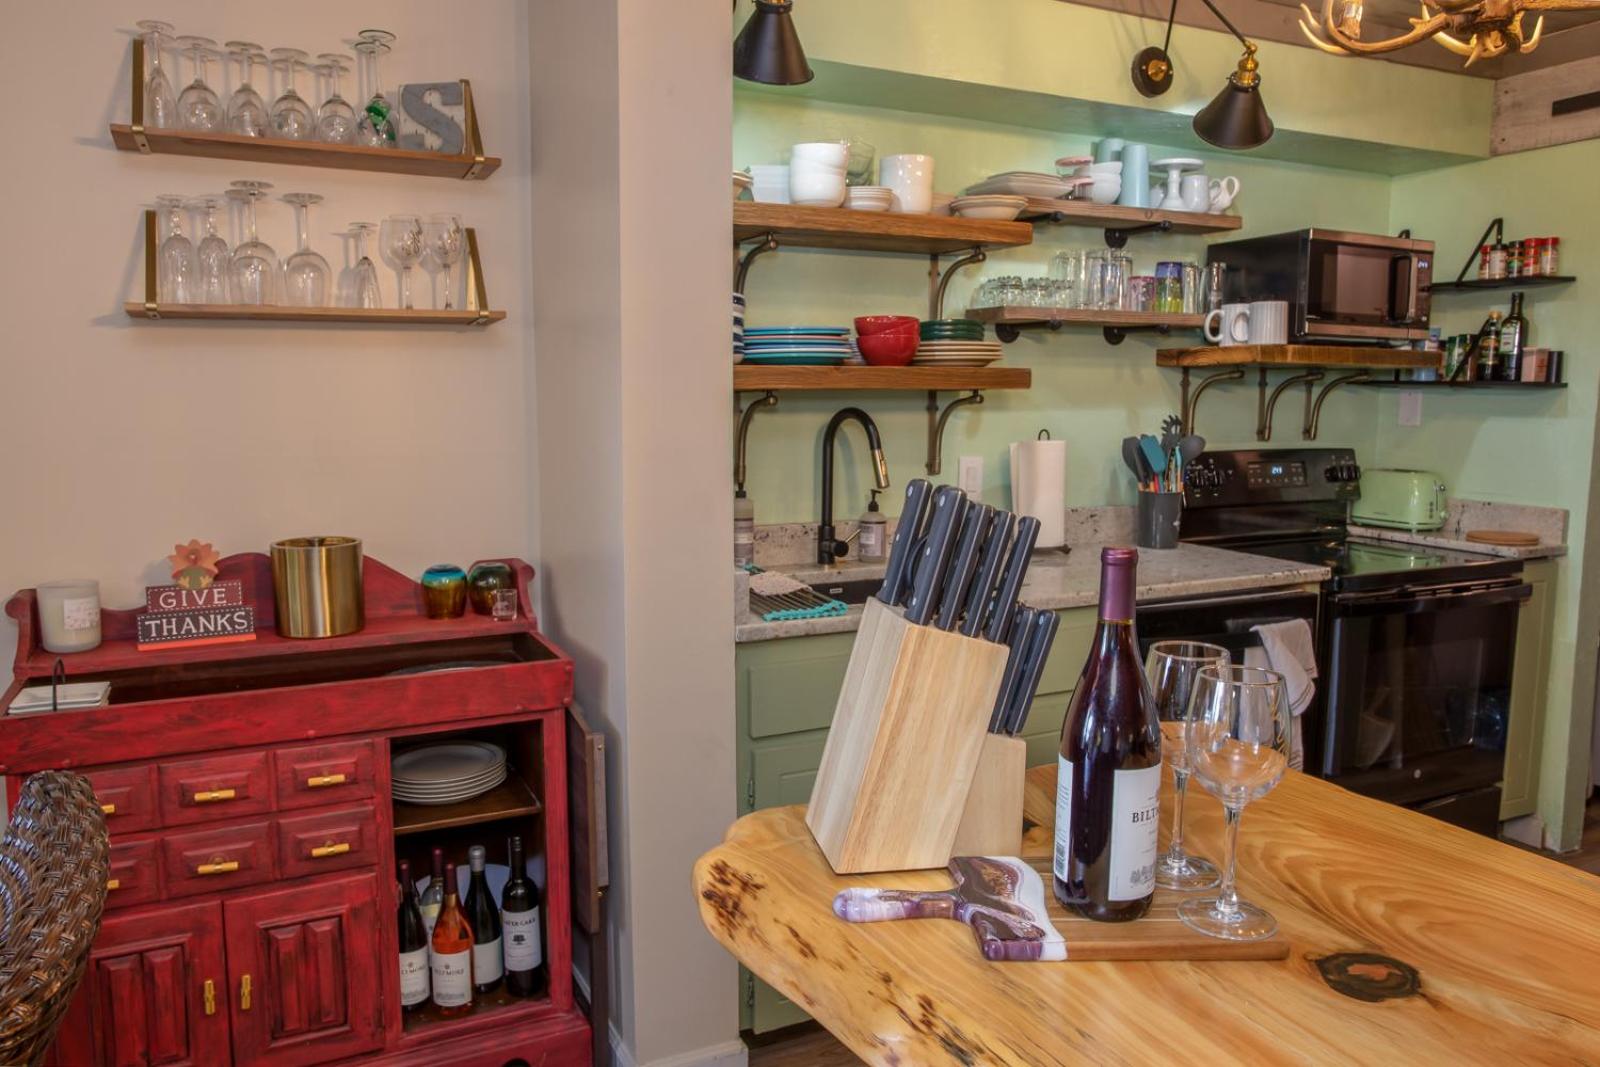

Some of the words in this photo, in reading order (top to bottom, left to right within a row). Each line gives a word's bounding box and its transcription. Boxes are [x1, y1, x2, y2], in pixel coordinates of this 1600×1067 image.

[400, 82, 463, 155] S
[159, 588, 227, 609] GIVE
[145, 611, 248, 637] THANKS
